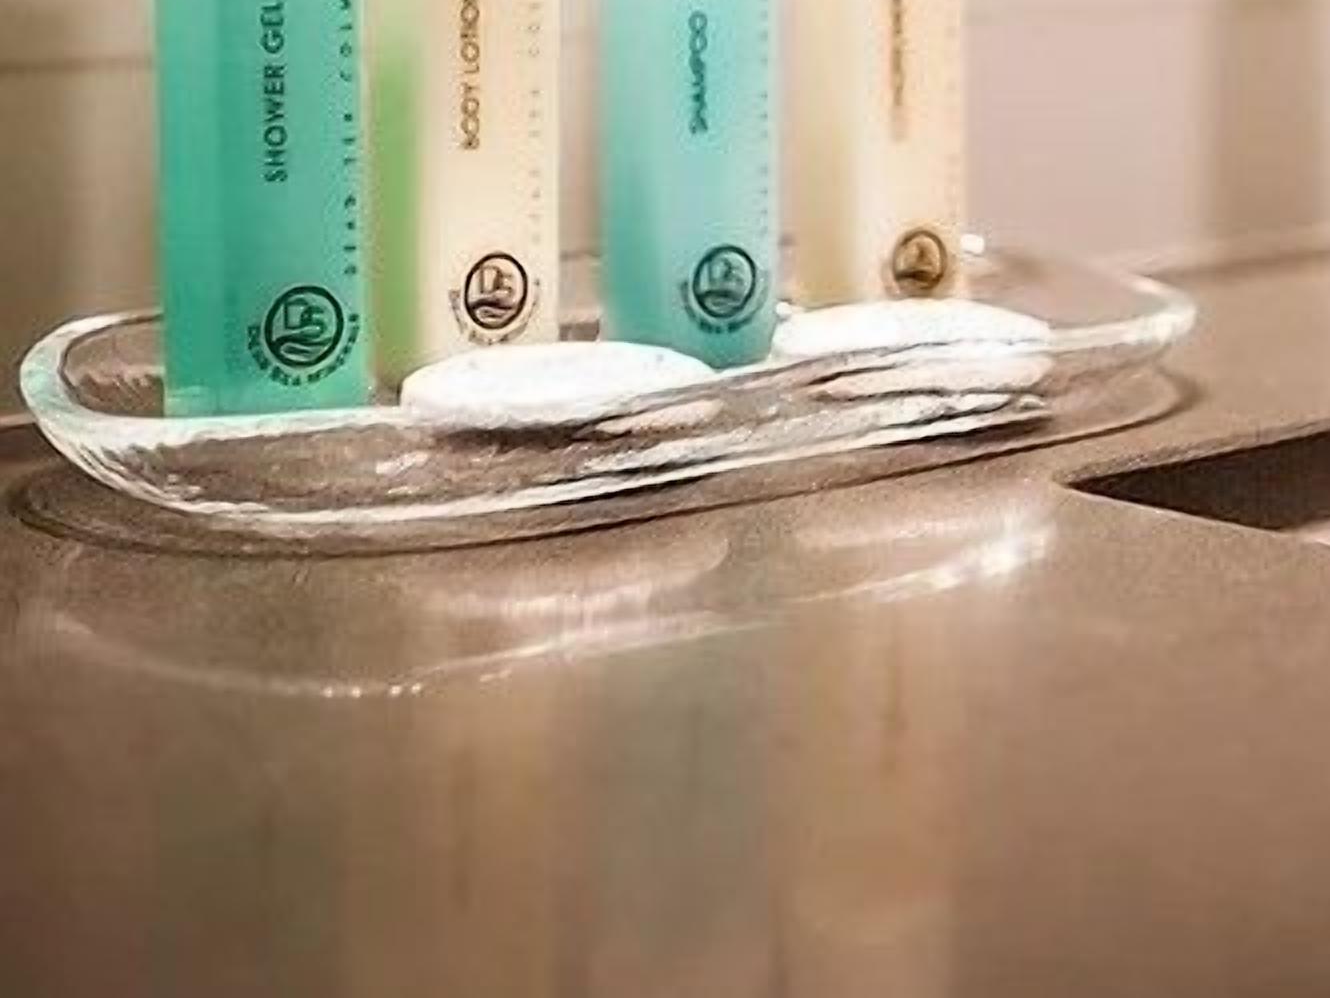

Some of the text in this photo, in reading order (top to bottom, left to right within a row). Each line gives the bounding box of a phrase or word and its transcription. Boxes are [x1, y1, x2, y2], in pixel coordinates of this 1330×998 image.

[260, 0, 288, 183] SHOWER GEL
[461, 81, 480, 149] BODY
